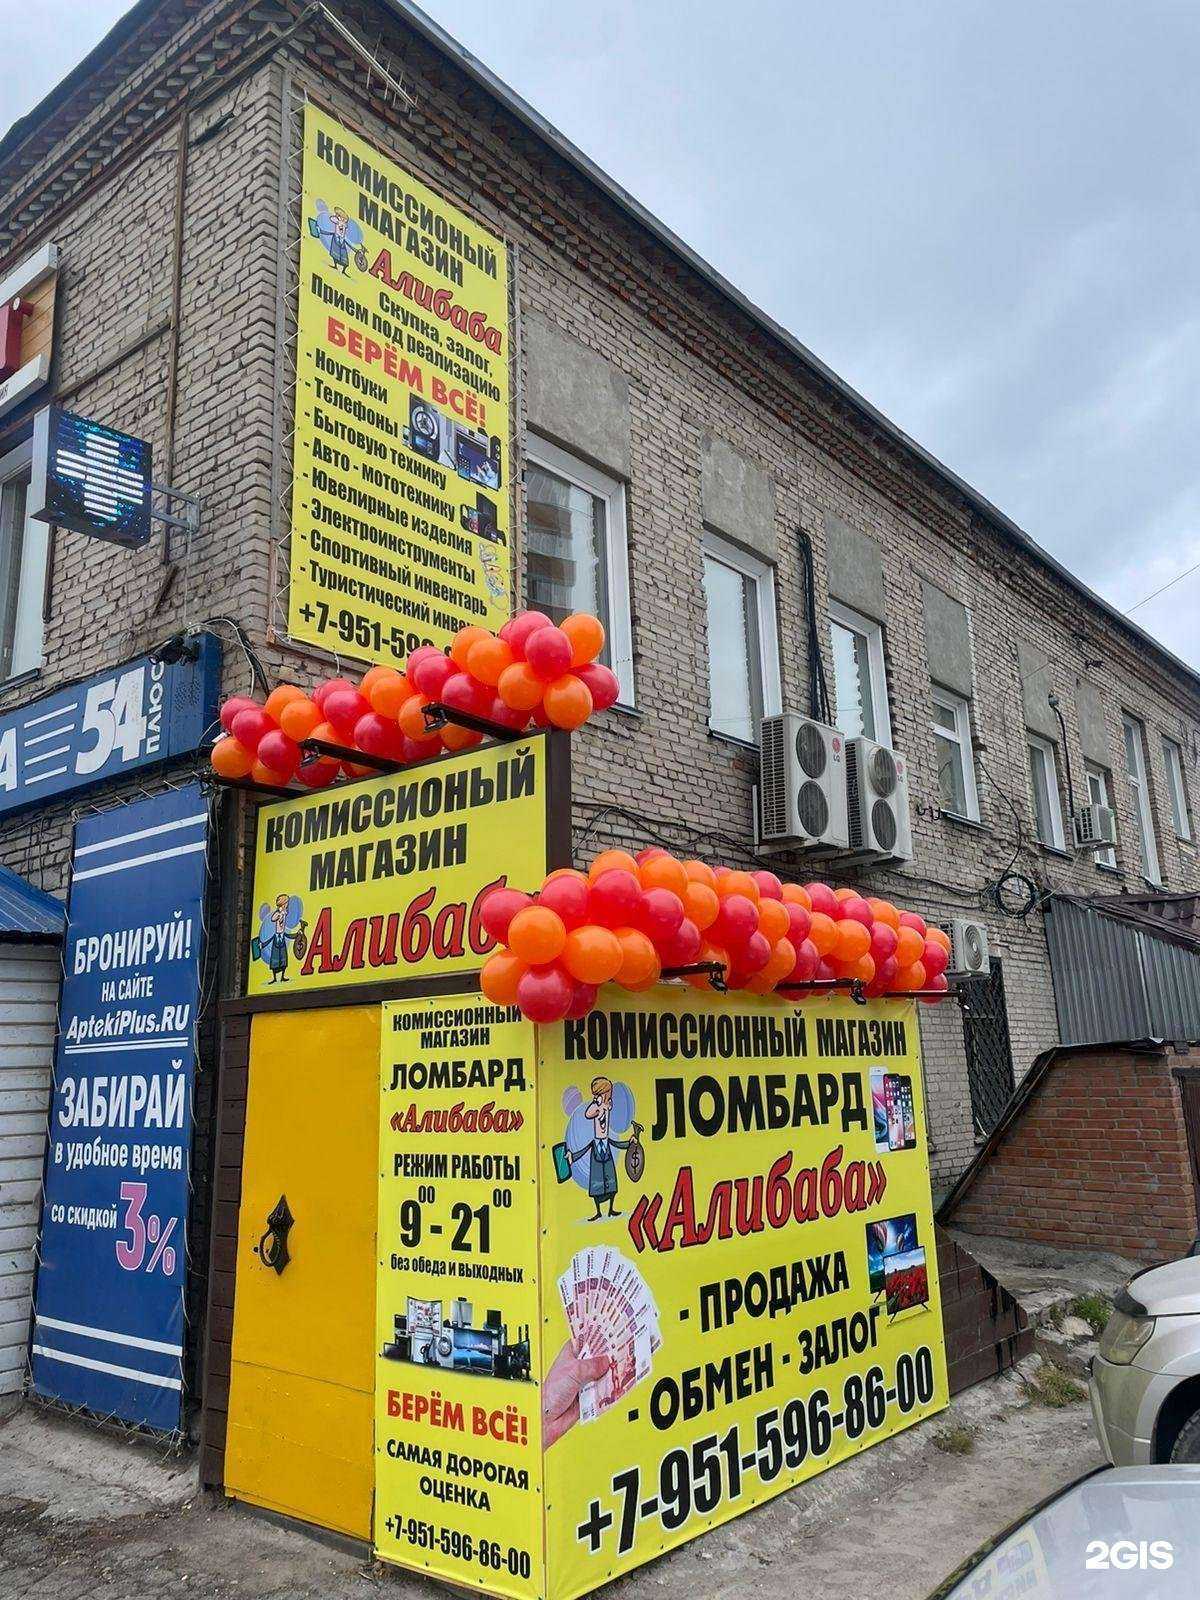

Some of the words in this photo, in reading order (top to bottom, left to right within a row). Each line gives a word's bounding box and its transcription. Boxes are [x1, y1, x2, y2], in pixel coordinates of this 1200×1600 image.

[317, 129, 498, 280] КОМИССИОНЫЙ
[358, 194, 464, 288] МАГАЗИН
[311, 272, 369, 326] Прием
[372, 310, 404, 348] под
[406, 332, 500, 402] реализацию
[368, 249, 502, 356] Алибаба
[379, 292, 443, 348] Скупка,
[446, 335, 493, 379] залог,
[314, 376, 398, 438] Телефоны
[315, 348, 388, 405] Ноутбуки
[327, 316, 423, 393] БЕРЁМ
[432, 377, 486, 427] ВСЁ!
[312, 437, 350, 472] Авто
[361, 463, 455, 523] мототехнику
[313, 407, 388, 459] Бытовую
[390, 443, 447, 491] технику
[310, 497, 476, 585] Электроинструменты
[312, 466, 409, 528] Ювелирные
[411, 513, 473, 557] изделия
[309, 559, 430, 626] Туристический
[310, 528, 411, 590] Спортивный
[414, 575, 488, 617] инвентарь
[75, 666, 147, 776] 54
[265, 745, 537, 855] КОМИССИОНЫЙ
[309, 822, 468, 892] МАГАЗИН
[74, 910, 193, 976] БРОНИРУЙ!
[300, 874, 525, 976] Алибаб
[66, 1003, 189, 1044] AptekiPlus.RU
[101, 981, 116, 1003] НА
[118, 972, 154, 1001] САЙТЕ
[420, 1027, 490, 1050] МАГАЗИН
[564, 1009, 807, 1060] КОМИССИОННЫЙ
[816, 1017, 907, 1057] МАГАЗИН
[58, 1058, 186, 1130] ЗАБИРАЙ
[390, 1057, 526, 1092] ЛОМБАРД
[651, 1071, 868, 1142] ЛОМБАРД
[389, 1101, 525, 1133] «Алибаба»
[54, 1141, 64, 1165] в
[65, 1135, 129, 1174] удобное
[132, 1141, 183, 1177] время
[394, 1153, 448, 1179] РЕЖИМ
[451, 1154, 521, 1182] РАБОТЫ
[51, 1203, 66, 1223] со
[67, 1202, 118, 1232] скидкой
[115, 1180, 179, 1278] 3%
[628, 1144, 887, 1254] «Алибаба»
[390, 1253, 410, 1273] без
[411, 1256, 447, 1277] обеда
[449, 1261, 456, 1276] и
[458, 1263, 524, 1284] выходных
[699, 1250, 850, 1333] ПРОДАЖА
[649, 1341, 775, 1431] ОБМЕН
[797, 1307, 880, 1376] ЗАЛОГ
[387, 1389, 465, 1433] БЕРЁМ
[472, 1405, 528, 1446] ВСЁ!
[577, 1346, 934, 1555] +7-951-596-86-00
[386, 1438, 442, 1470] САМАЯ
[446, 1452, 529, 1491] ДОРОГАЯ
[419, 1475, 491, 1513] ОЦЕНКА
[385, 1514, 531, 1580] +7-951-596-86-00
